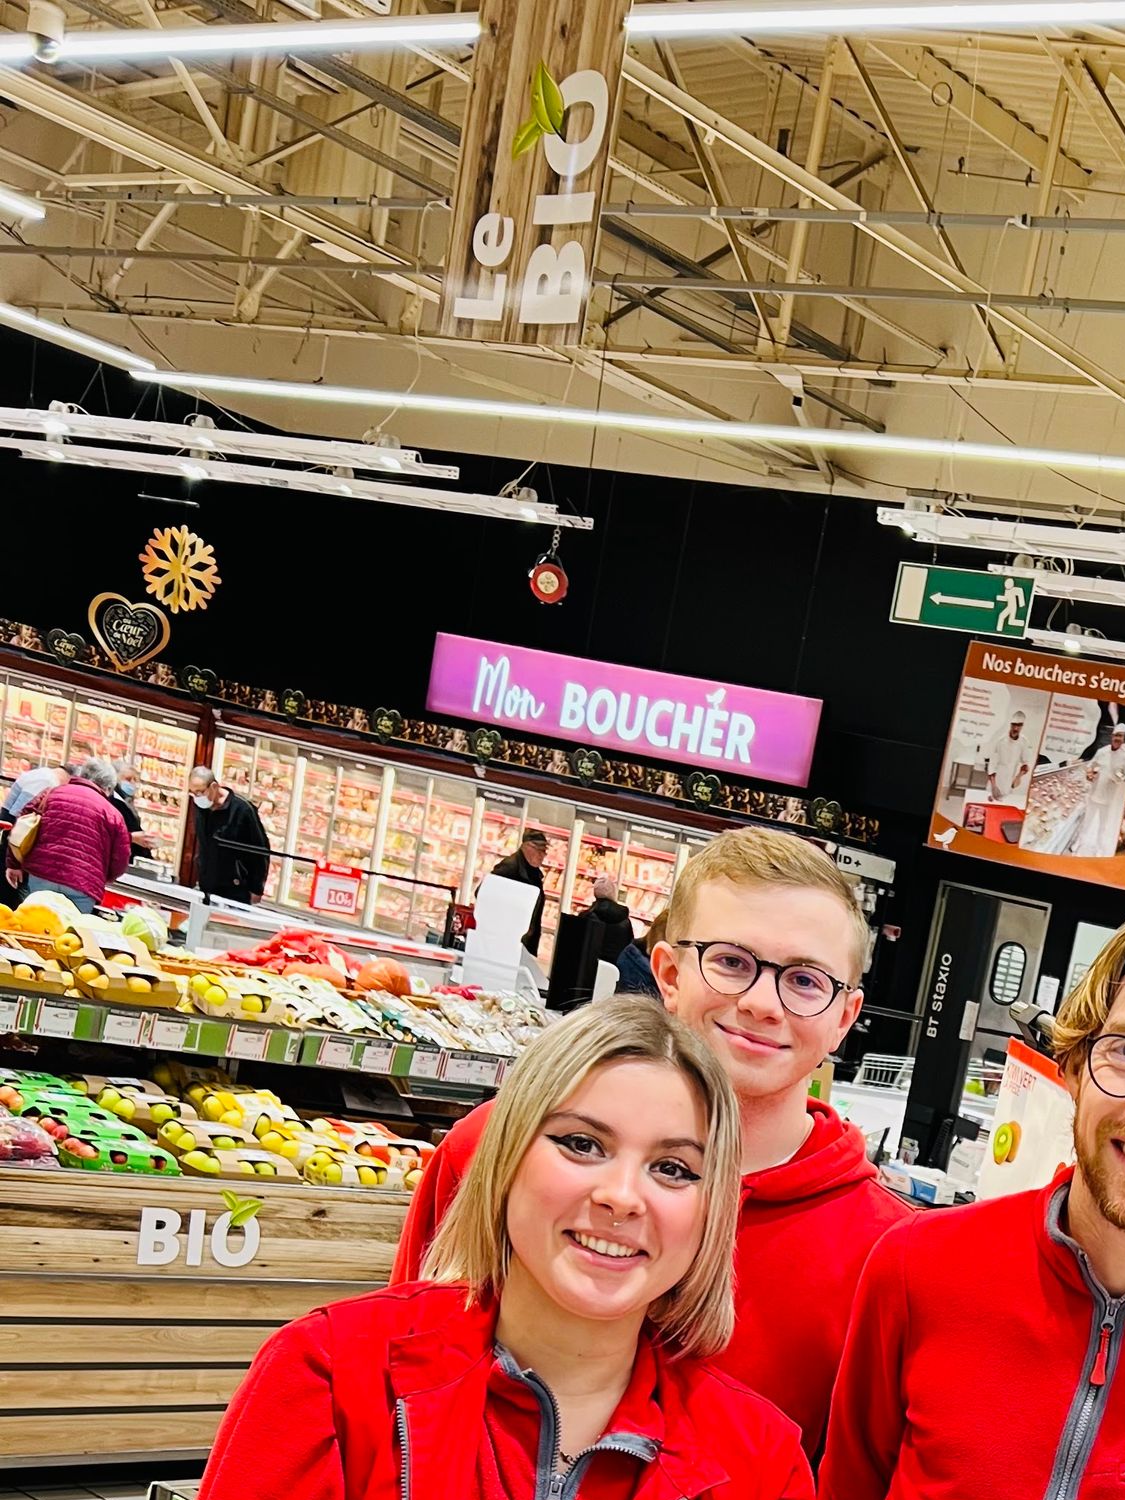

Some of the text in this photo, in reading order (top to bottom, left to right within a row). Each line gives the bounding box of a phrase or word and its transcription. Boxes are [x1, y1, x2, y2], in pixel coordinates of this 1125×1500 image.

[518, 69, 609, 324] BIO
[453, 211, 514, 322] Le
[472, 656, 545, 720] Mon
[982, 652, 1012, 674] Nos
[1014, 657, 1087, 687] bouchers
[926, 1017, 940, 1038] BT
[136, 1205, 262, 1268] BIO
